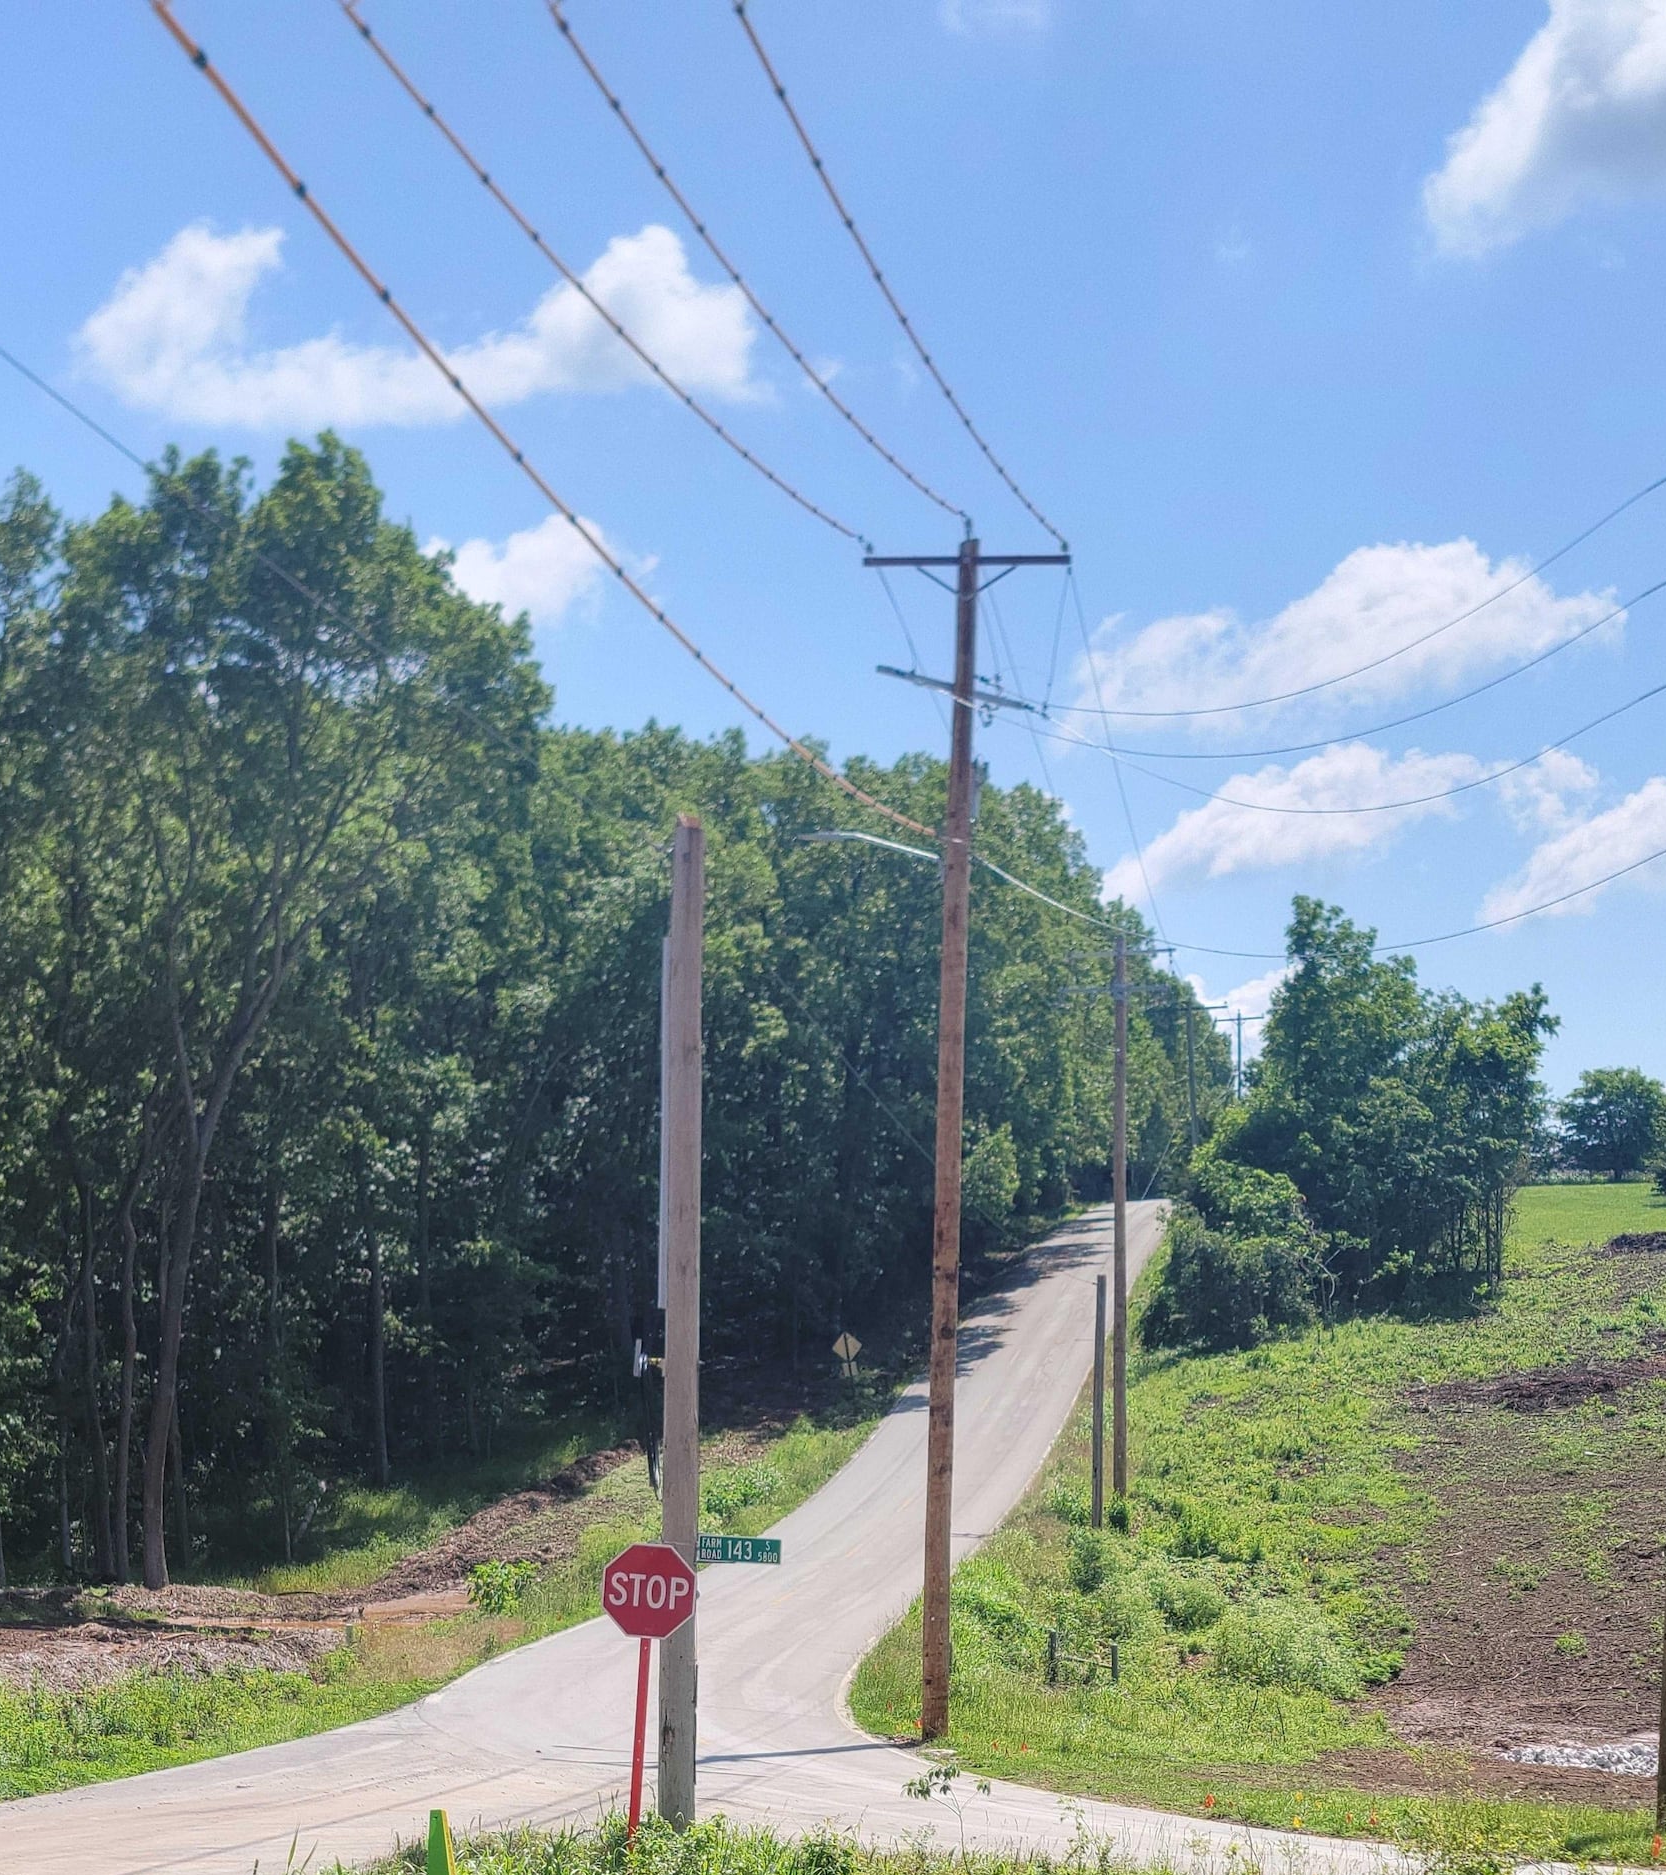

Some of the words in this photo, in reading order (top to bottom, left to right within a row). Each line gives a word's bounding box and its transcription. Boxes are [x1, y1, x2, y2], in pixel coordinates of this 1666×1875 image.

[701, 1537, 722, 1549] FARM
[765, 1541, 771, 1551] S
[701, 1549, 722, 1560] ROAD
[727, 1540, 753, 1560] 143
[757, 1552, 778, 1563] 5800
[608, 1571, 690, 1610] STOP
